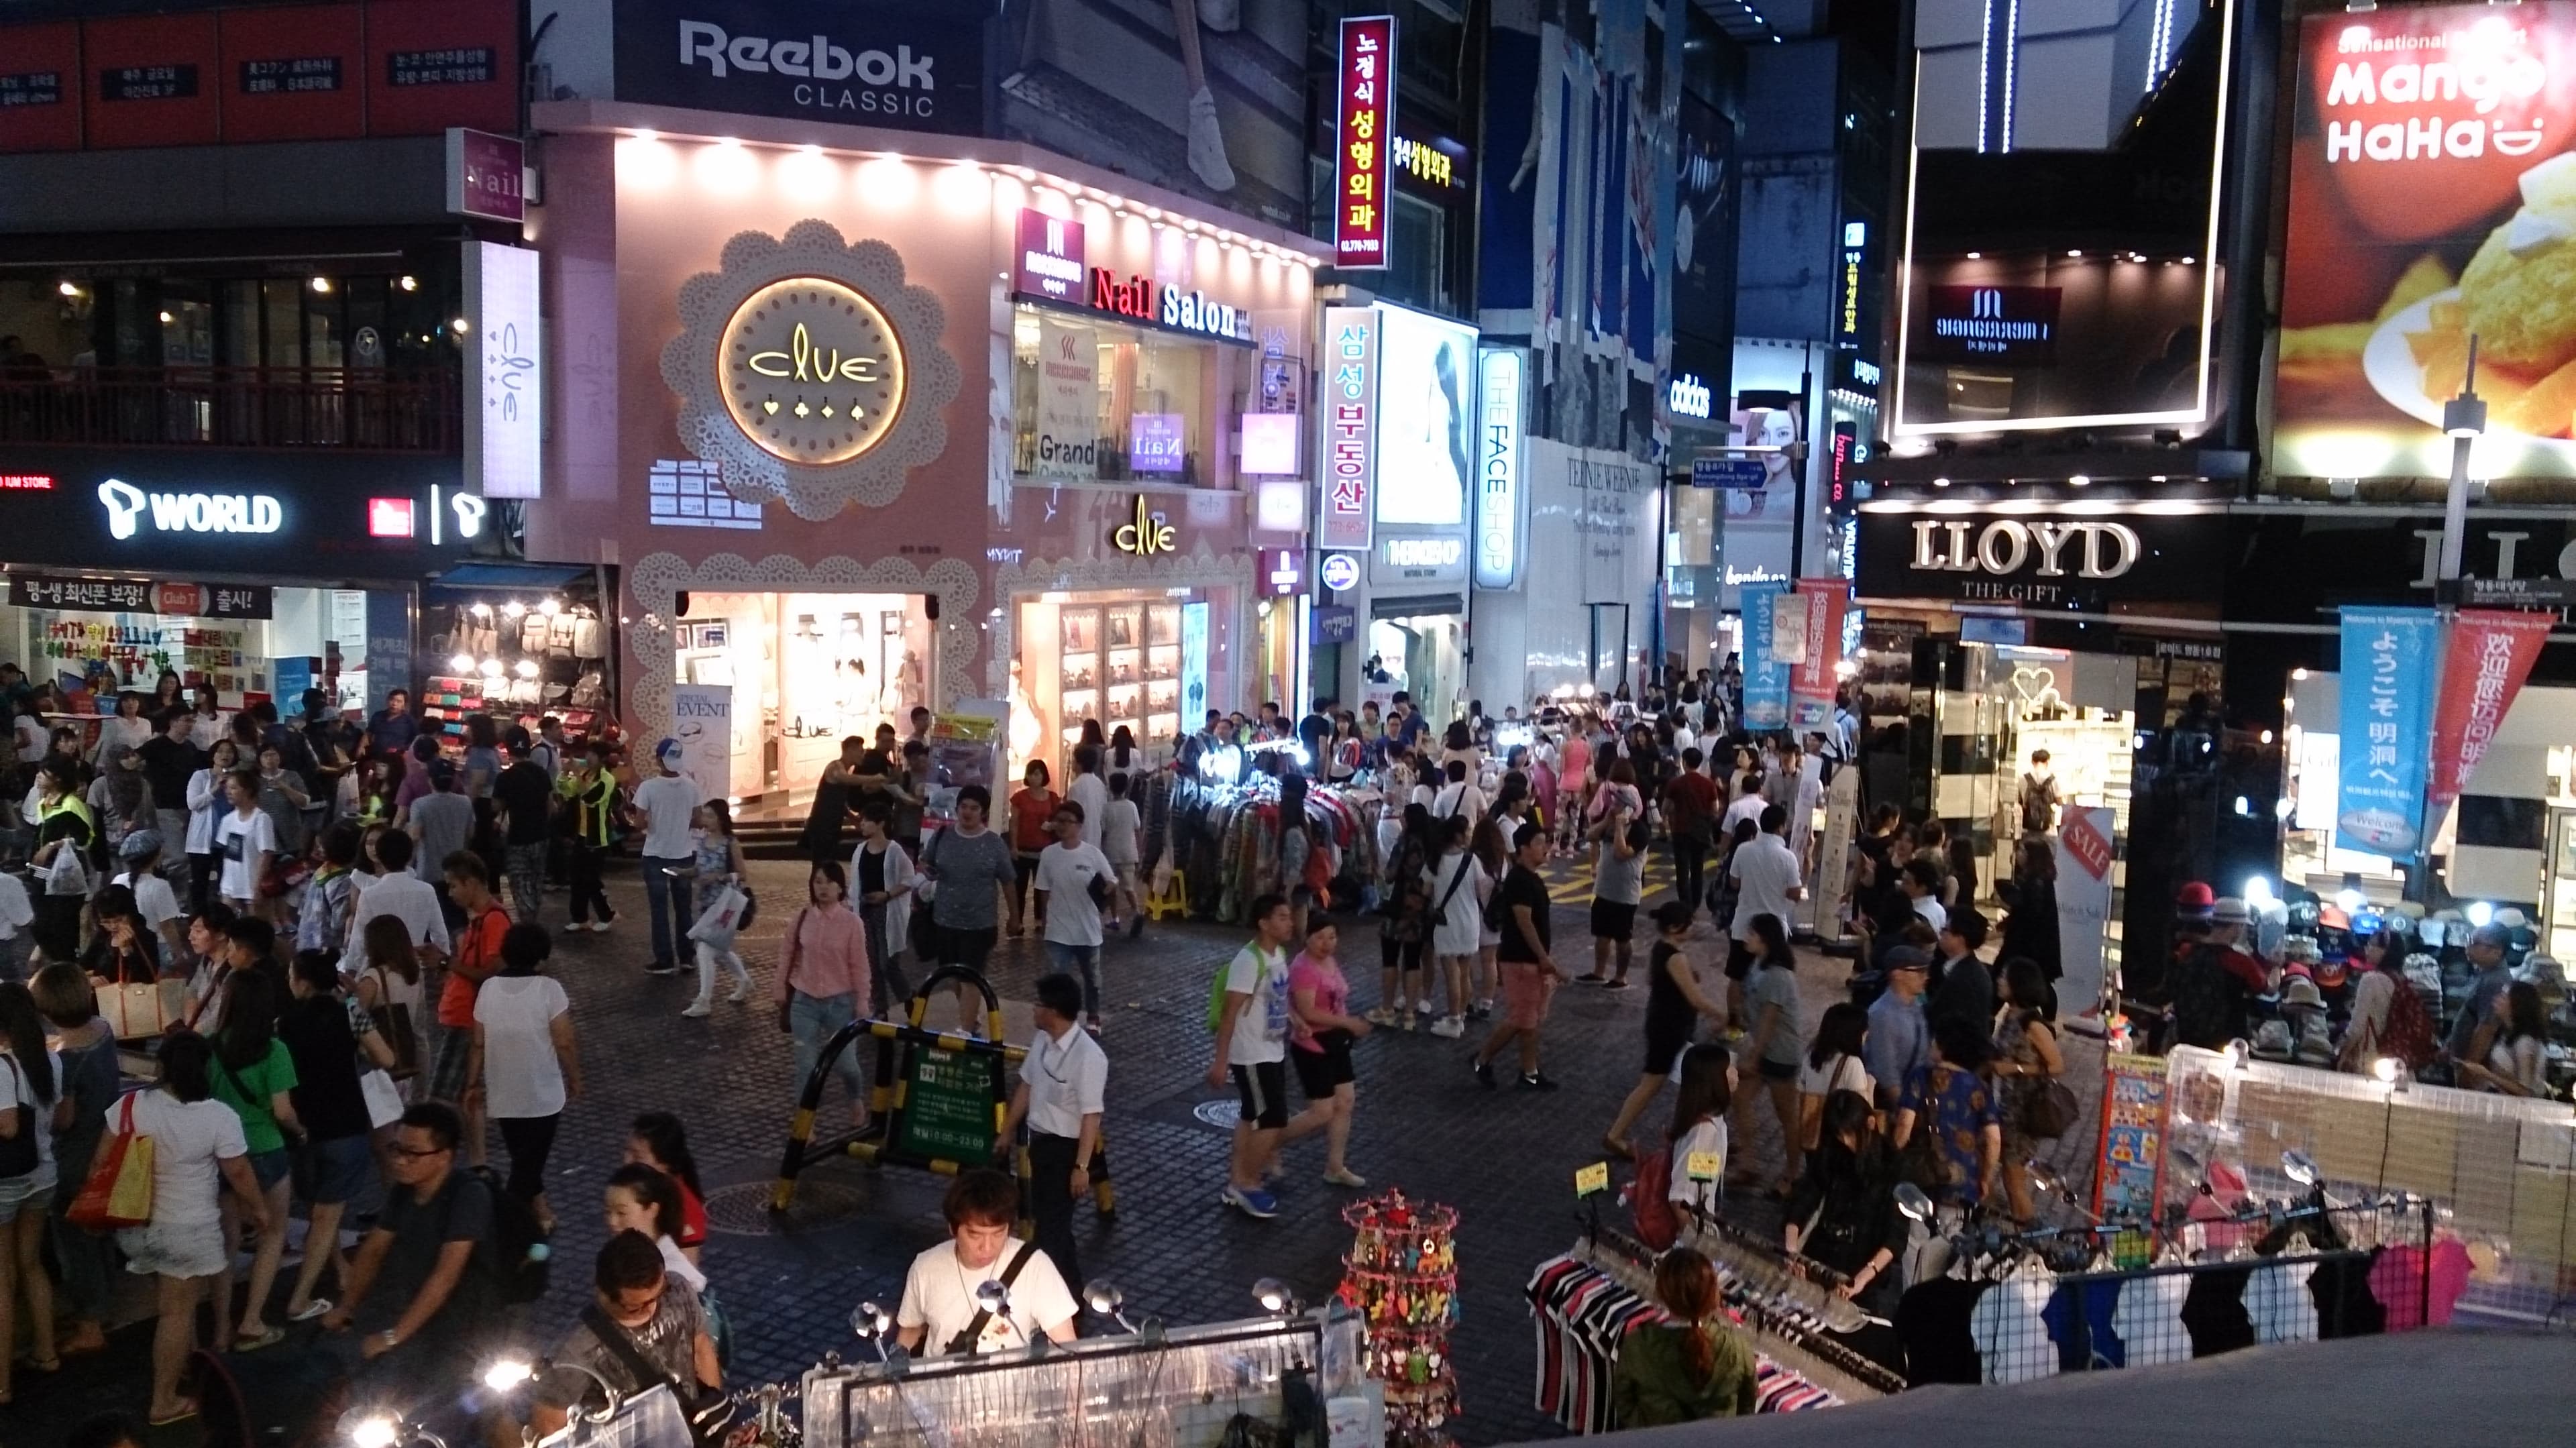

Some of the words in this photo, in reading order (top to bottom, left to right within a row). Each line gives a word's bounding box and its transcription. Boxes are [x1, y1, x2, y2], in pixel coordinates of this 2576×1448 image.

[680, 19, 934, 90] Reebok
[794, 84, 934, 117] CLASSIC
[2326, 60, 2547, 115] Mango
[2327, 115, 2486, 163] HaHa
[467, 165, 520, 198] Nail
[1095, 267, 1155, 321] Nail
[1163, 282, 1236, 338] Salon
[1670, 373, 1711, 419] adidas
[1040, 434, 1095, 465] Grand
[23, 477, 51, 489] STORE
[150, 493, 282, 533] WORLD
[1909, 519, 2142, 578] LLOYD
[66, 583, 108, 605] 최신폰
[111, 585, 144, 606] 보장!
[216, 590, 252, 612] 출시!
[1962, 581, 2003, 600] THE
[2008, 584, 2061, 602] GIFT
[676, 702, 730, 718] EVENT
[2069, 825, 2109, 871] SALE
